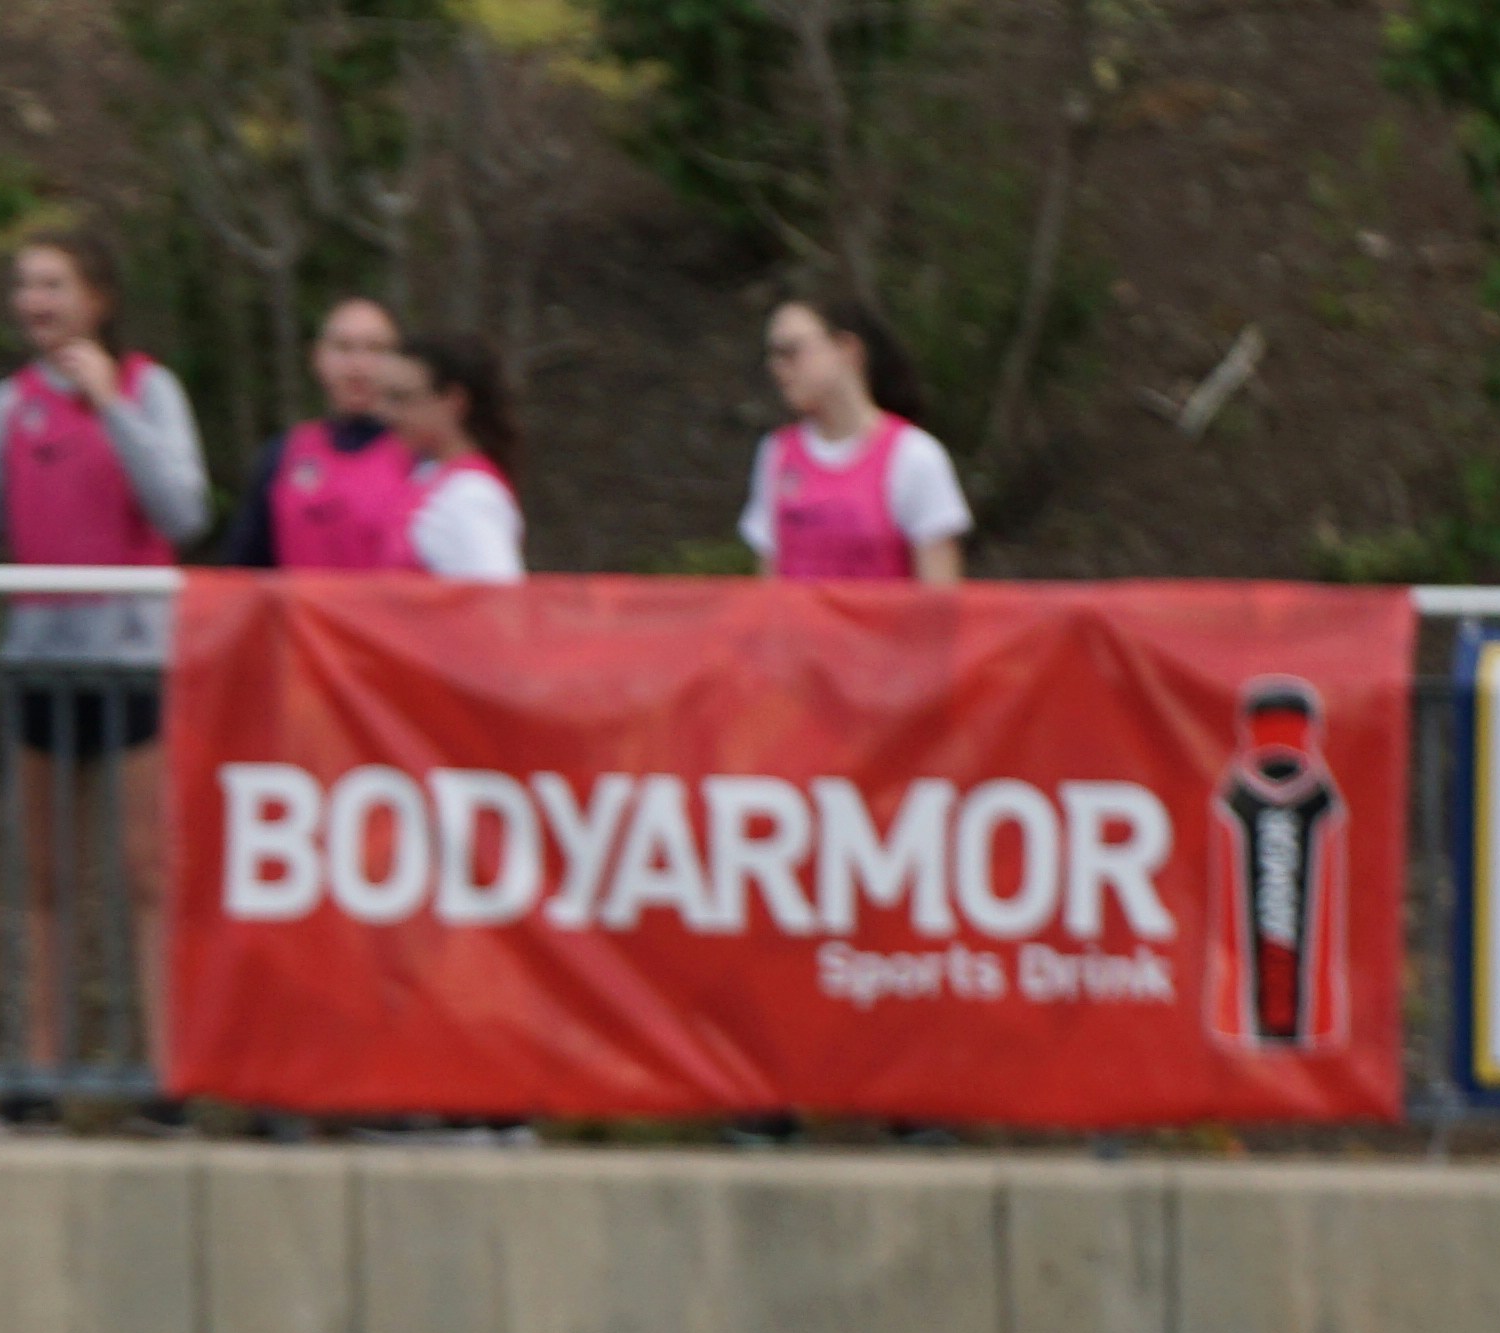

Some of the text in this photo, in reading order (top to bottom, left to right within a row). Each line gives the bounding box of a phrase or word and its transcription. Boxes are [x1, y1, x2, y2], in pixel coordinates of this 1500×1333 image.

[219, 762, 1180, 941] BODYARMOR
[816, 939, 1176, 1011] Sports Drink
